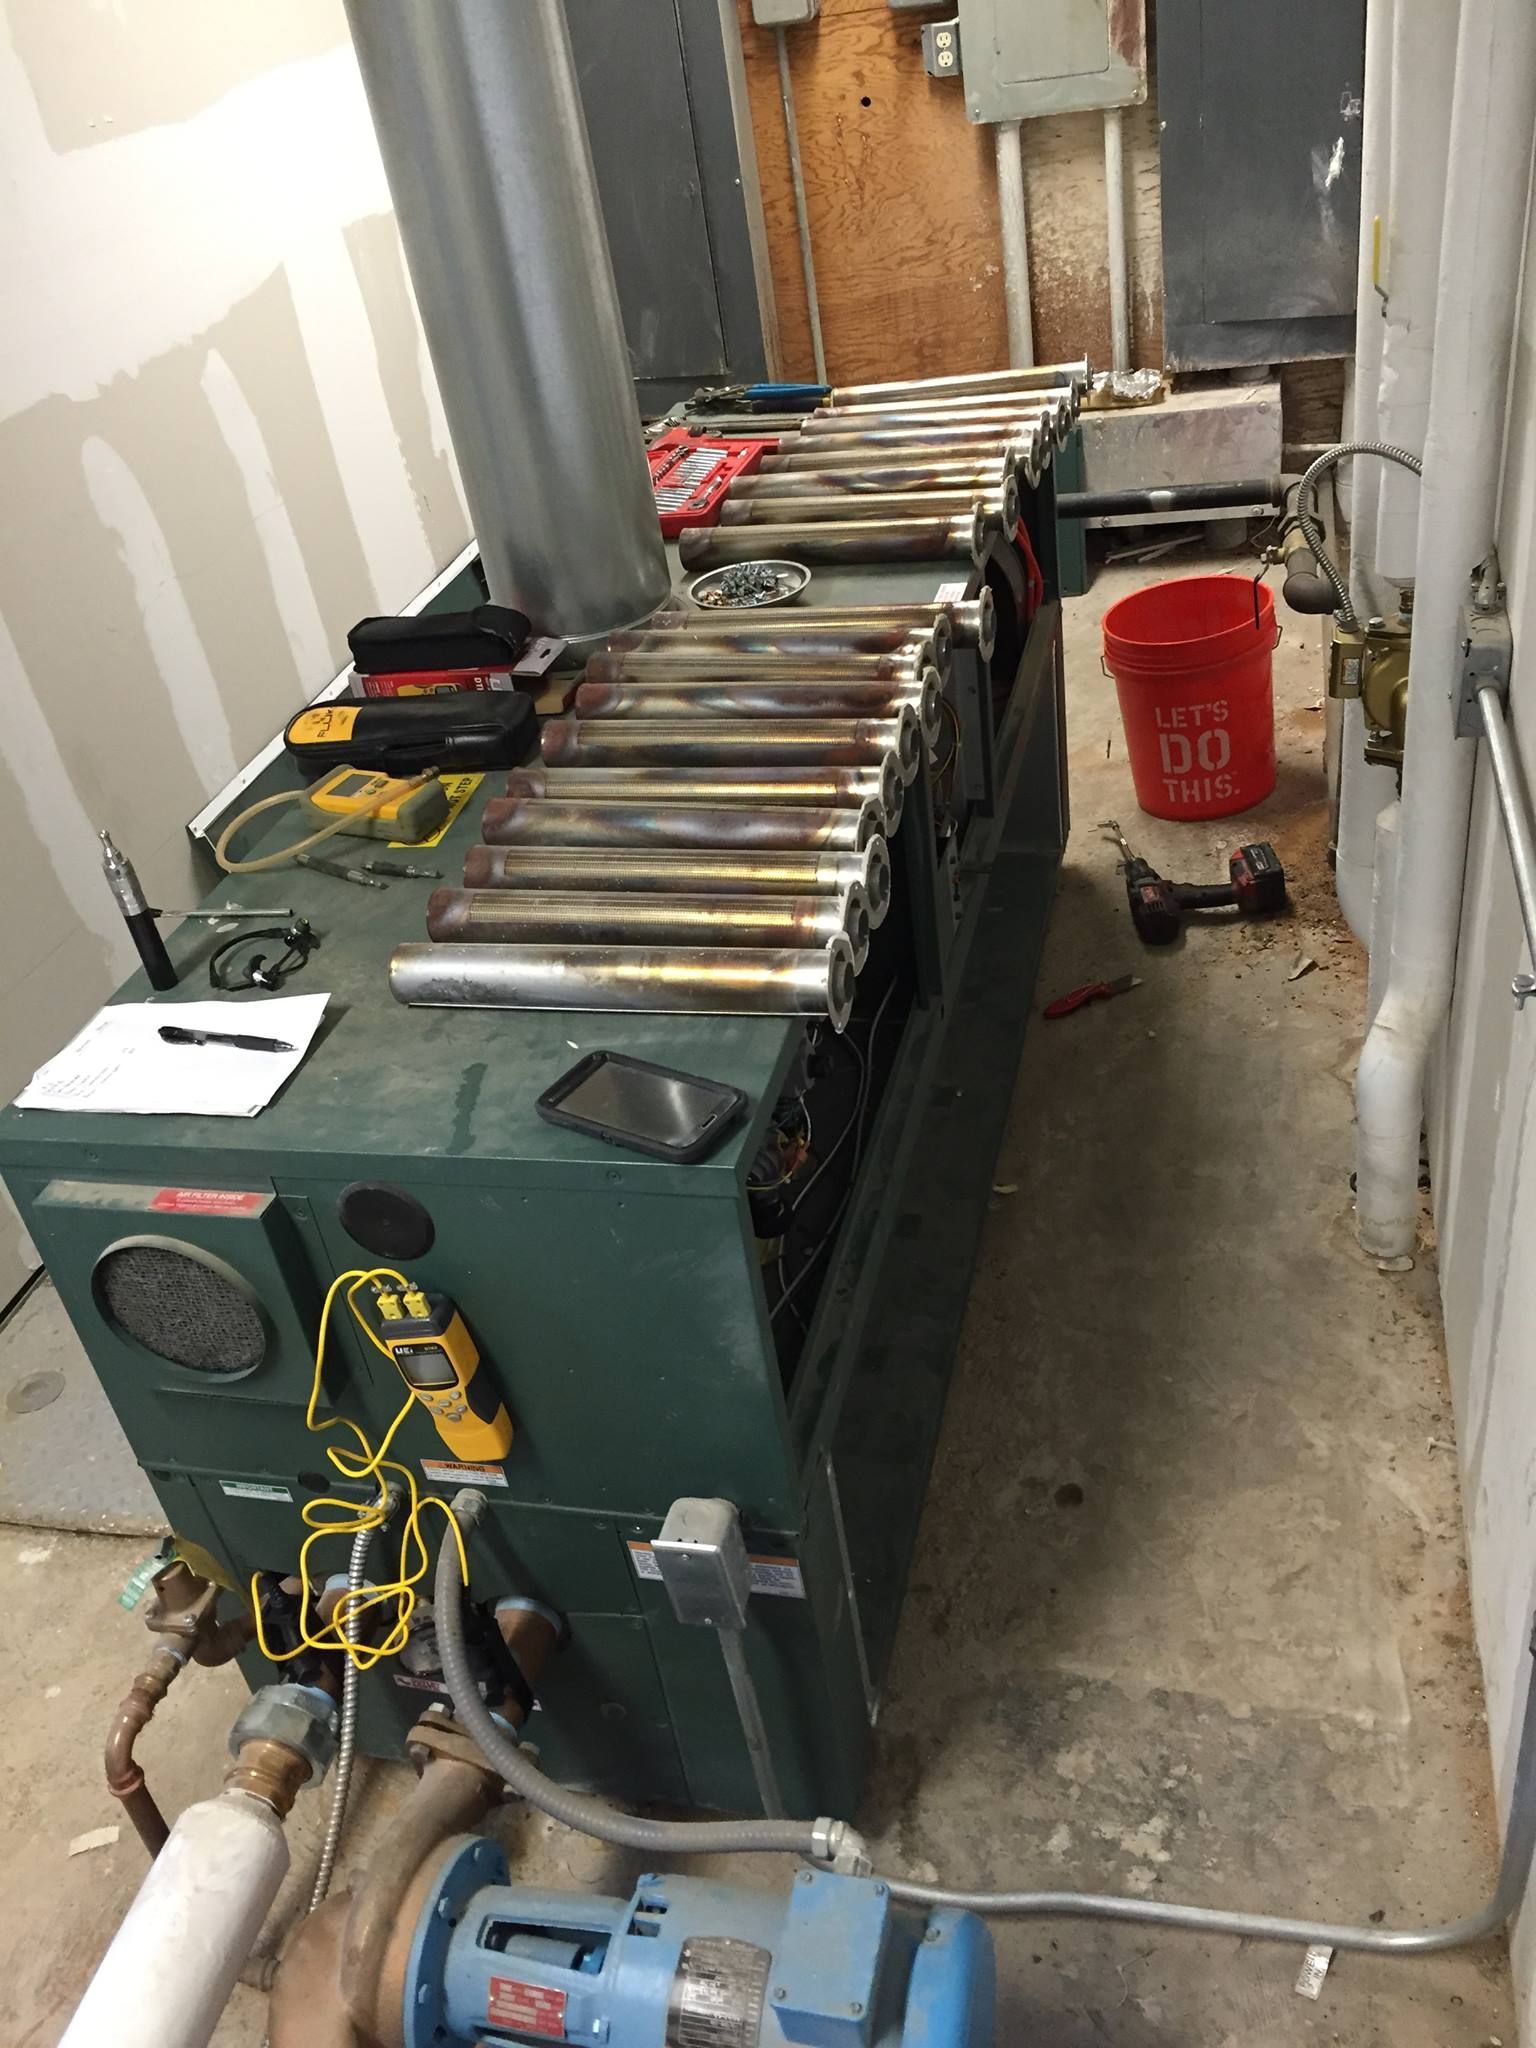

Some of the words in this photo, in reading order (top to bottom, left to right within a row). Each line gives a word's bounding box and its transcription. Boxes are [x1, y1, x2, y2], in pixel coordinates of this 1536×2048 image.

[1155, 700, 1229, 728] LET'S
[1159, 728, 1231, 775] DO
[454, 777, 472, 794] STEP
[1163, 774, 1240, 802] THIS.
[444, 1463, 486, 1472] WARNING
